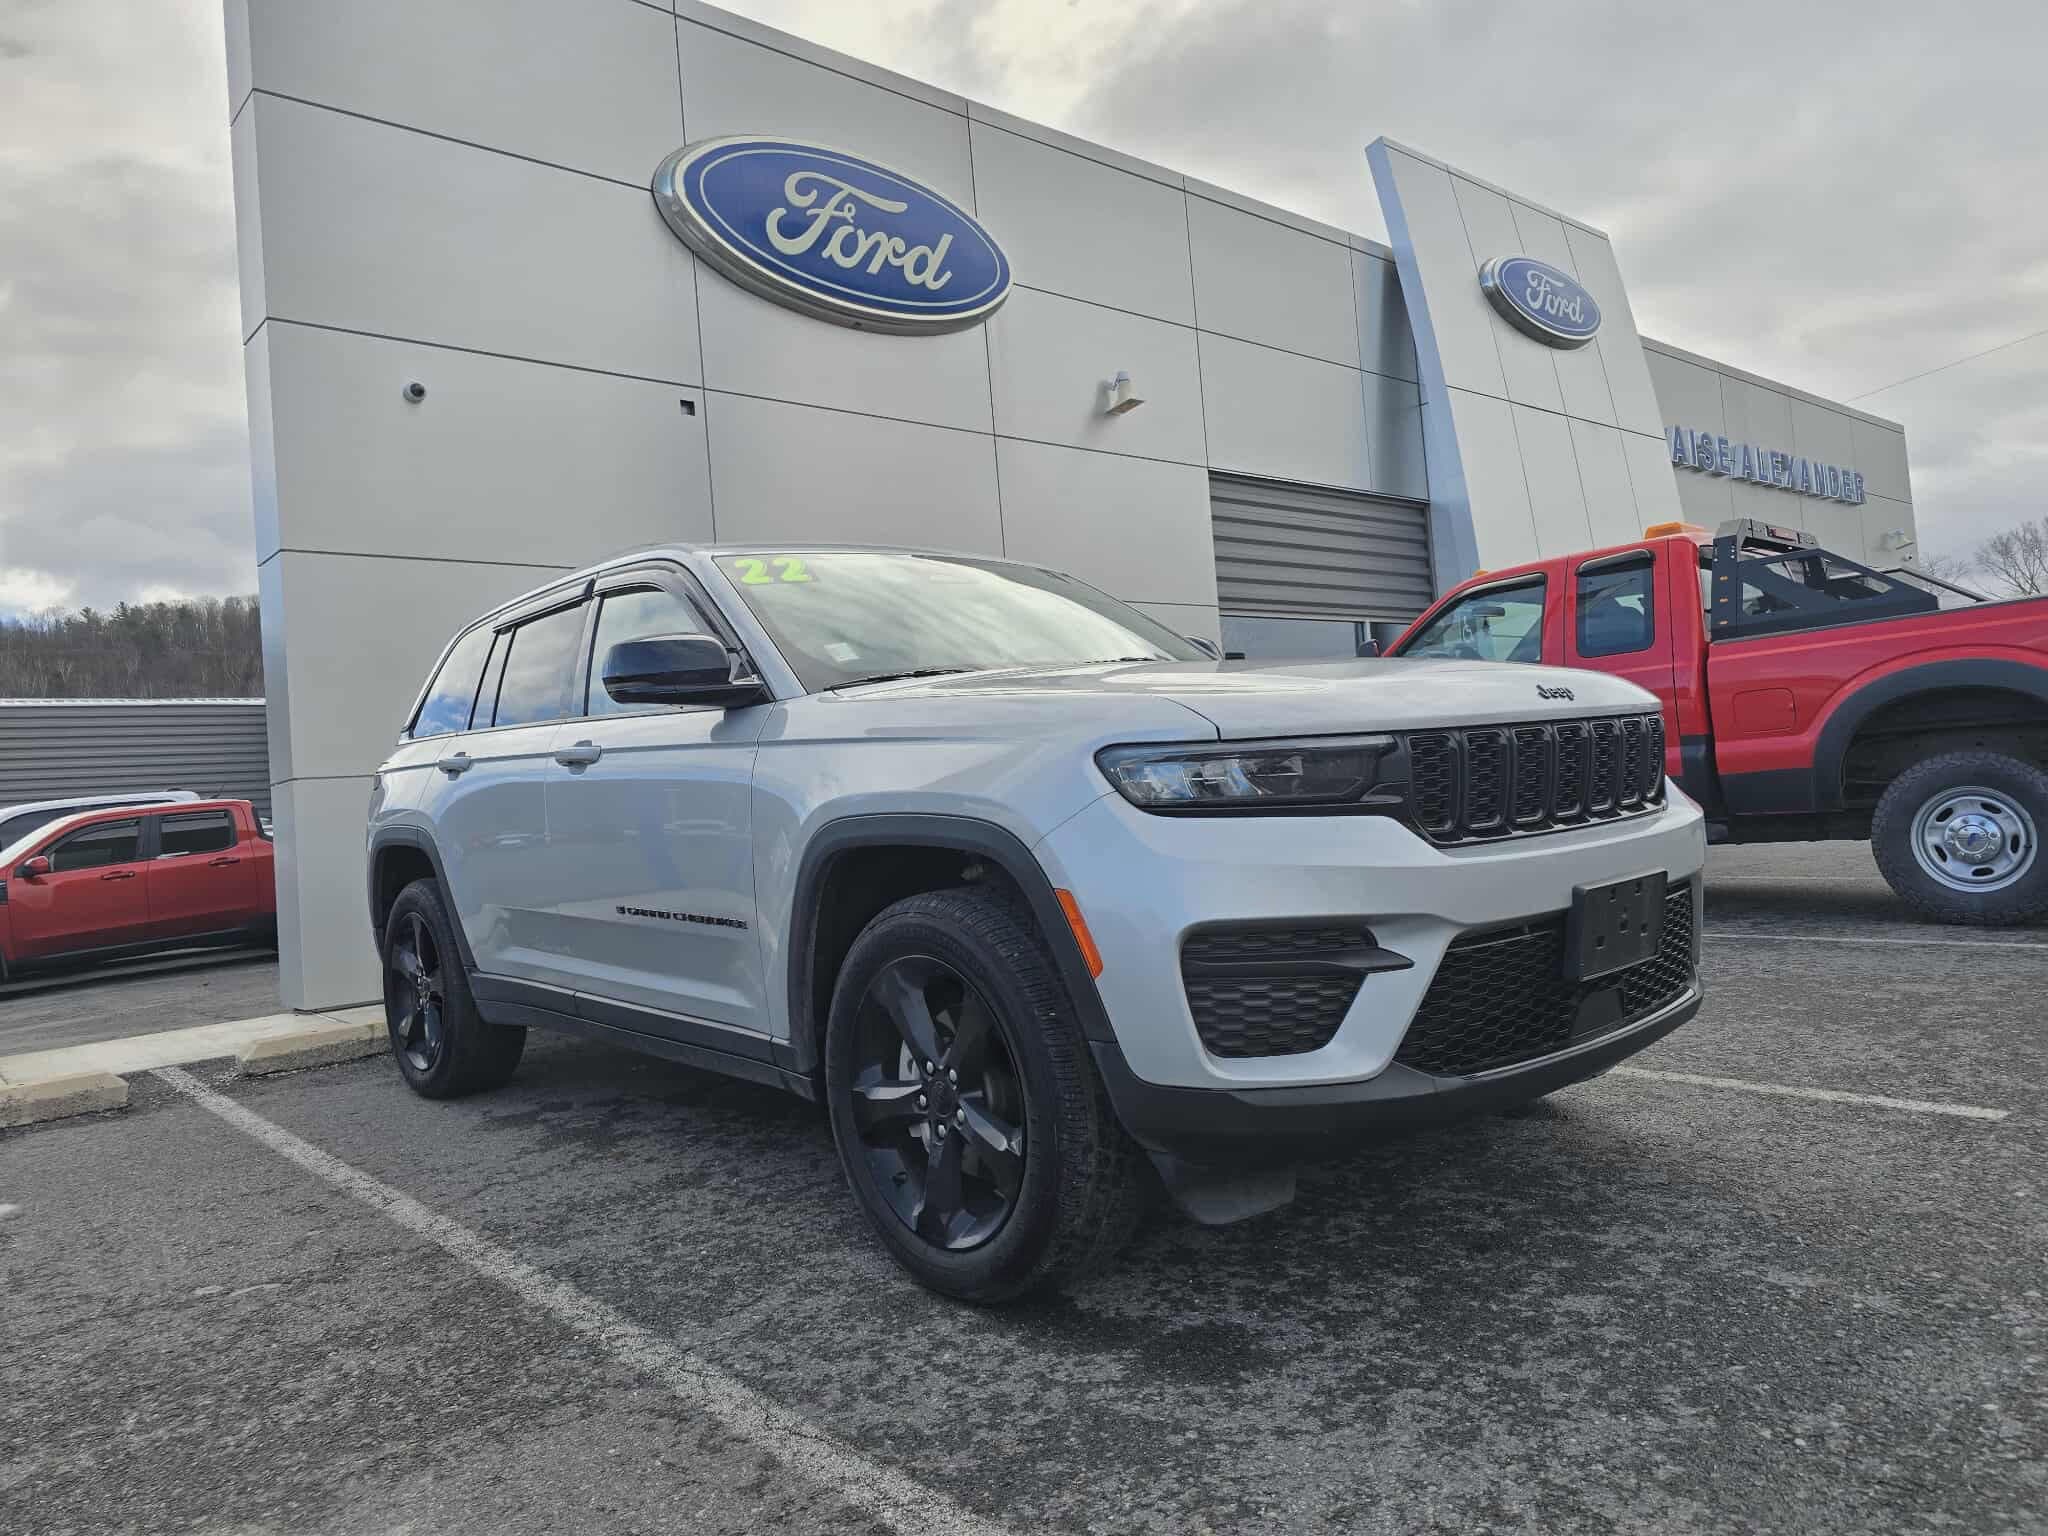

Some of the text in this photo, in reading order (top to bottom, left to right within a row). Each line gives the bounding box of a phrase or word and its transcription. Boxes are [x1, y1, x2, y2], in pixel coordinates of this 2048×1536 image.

[766, 171, 953, 290] Ford
[1526, 270, 1584, 324] Ford
[1665, 425, 1866, 504] AISE ALEXANDER
[735, 557, 813, 585] 22
[1536, 684, 1575, 701] Jeep
